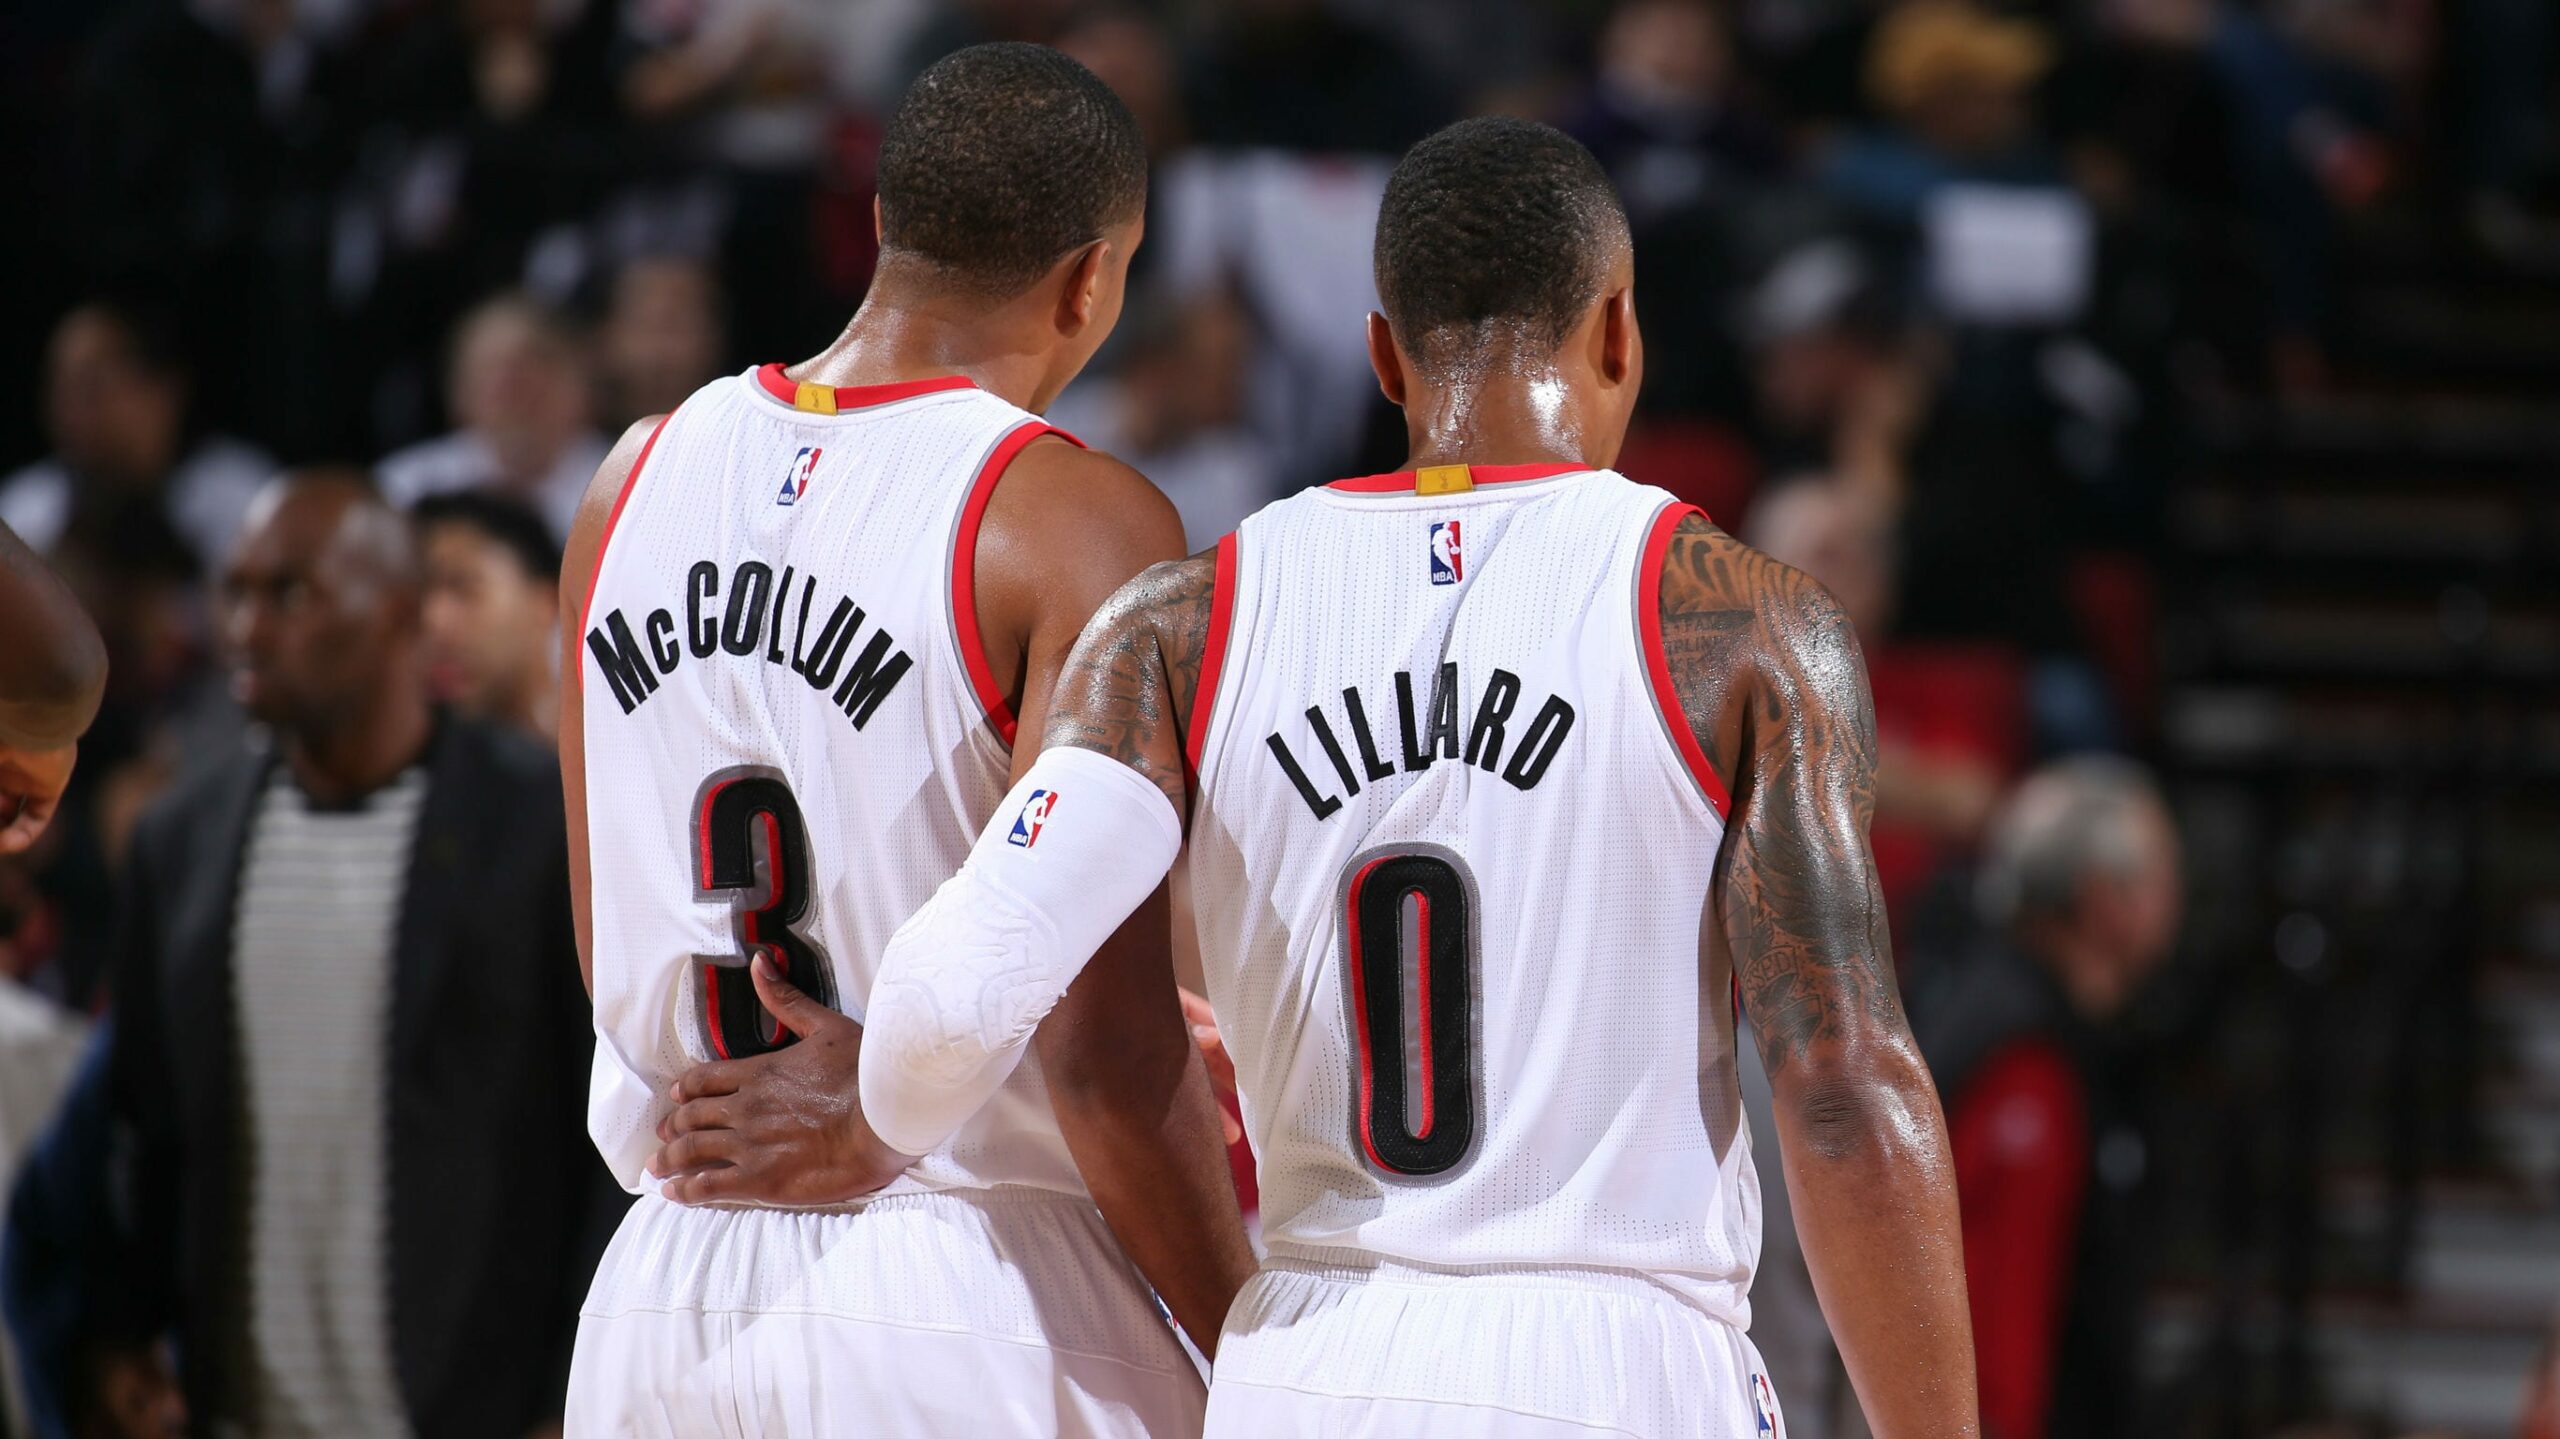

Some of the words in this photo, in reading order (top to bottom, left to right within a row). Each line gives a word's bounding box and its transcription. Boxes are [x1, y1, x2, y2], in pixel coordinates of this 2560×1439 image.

[586, 560, 914, 732] McCOLLUM
[1432, 571, 1454, 583] NBA
[1266, 661, 1576, 821] LILLARD
[690, 764, 842, 1060] 3
[1337, 842, 1486, 1187] 0
